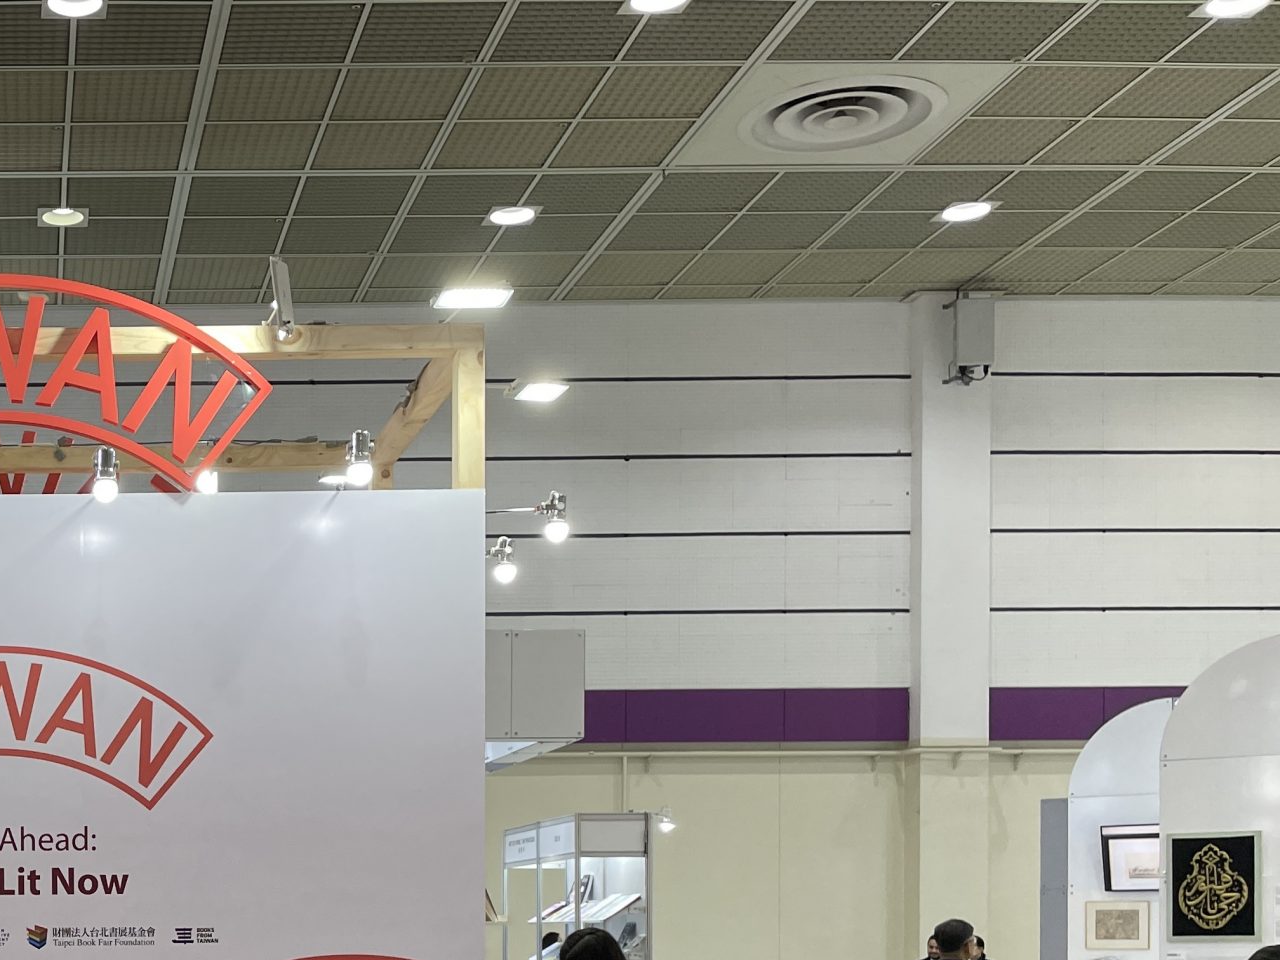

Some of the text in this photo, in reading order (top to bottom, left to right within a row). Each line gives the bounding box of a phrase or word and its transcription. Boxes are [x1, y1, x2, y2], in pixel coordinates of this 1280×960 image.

[51, 868, 129, 896] Now
[52, 927, 156, 938] 財團法人台北書展基金會
[53, 939, 74, 948] Taipei
